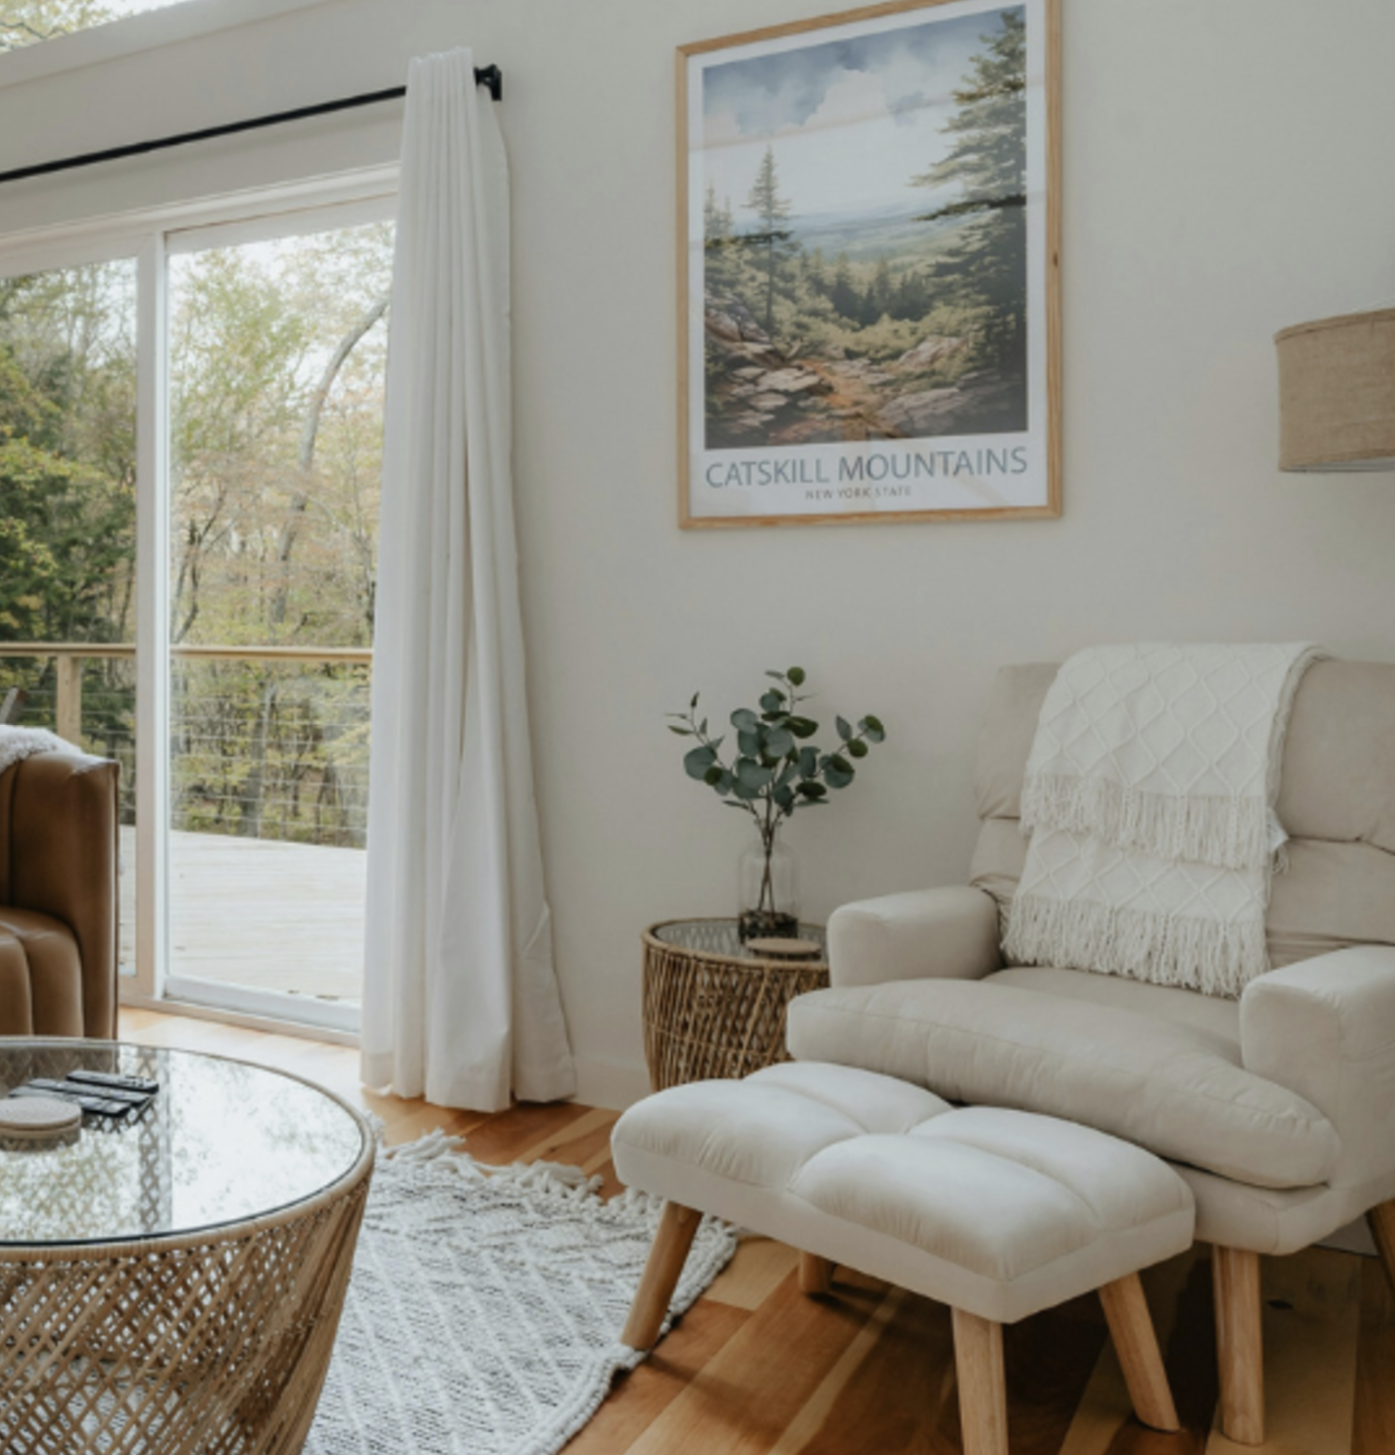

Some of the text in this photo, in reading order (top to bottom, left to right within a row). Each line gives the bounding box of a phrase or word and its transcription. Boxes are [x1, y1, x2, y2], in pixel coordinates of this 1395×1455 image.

[706, 446, 1027, 488] CATSKILL MOUNTAINS
[805, 485, 911, 500] NEW YORK STATE
